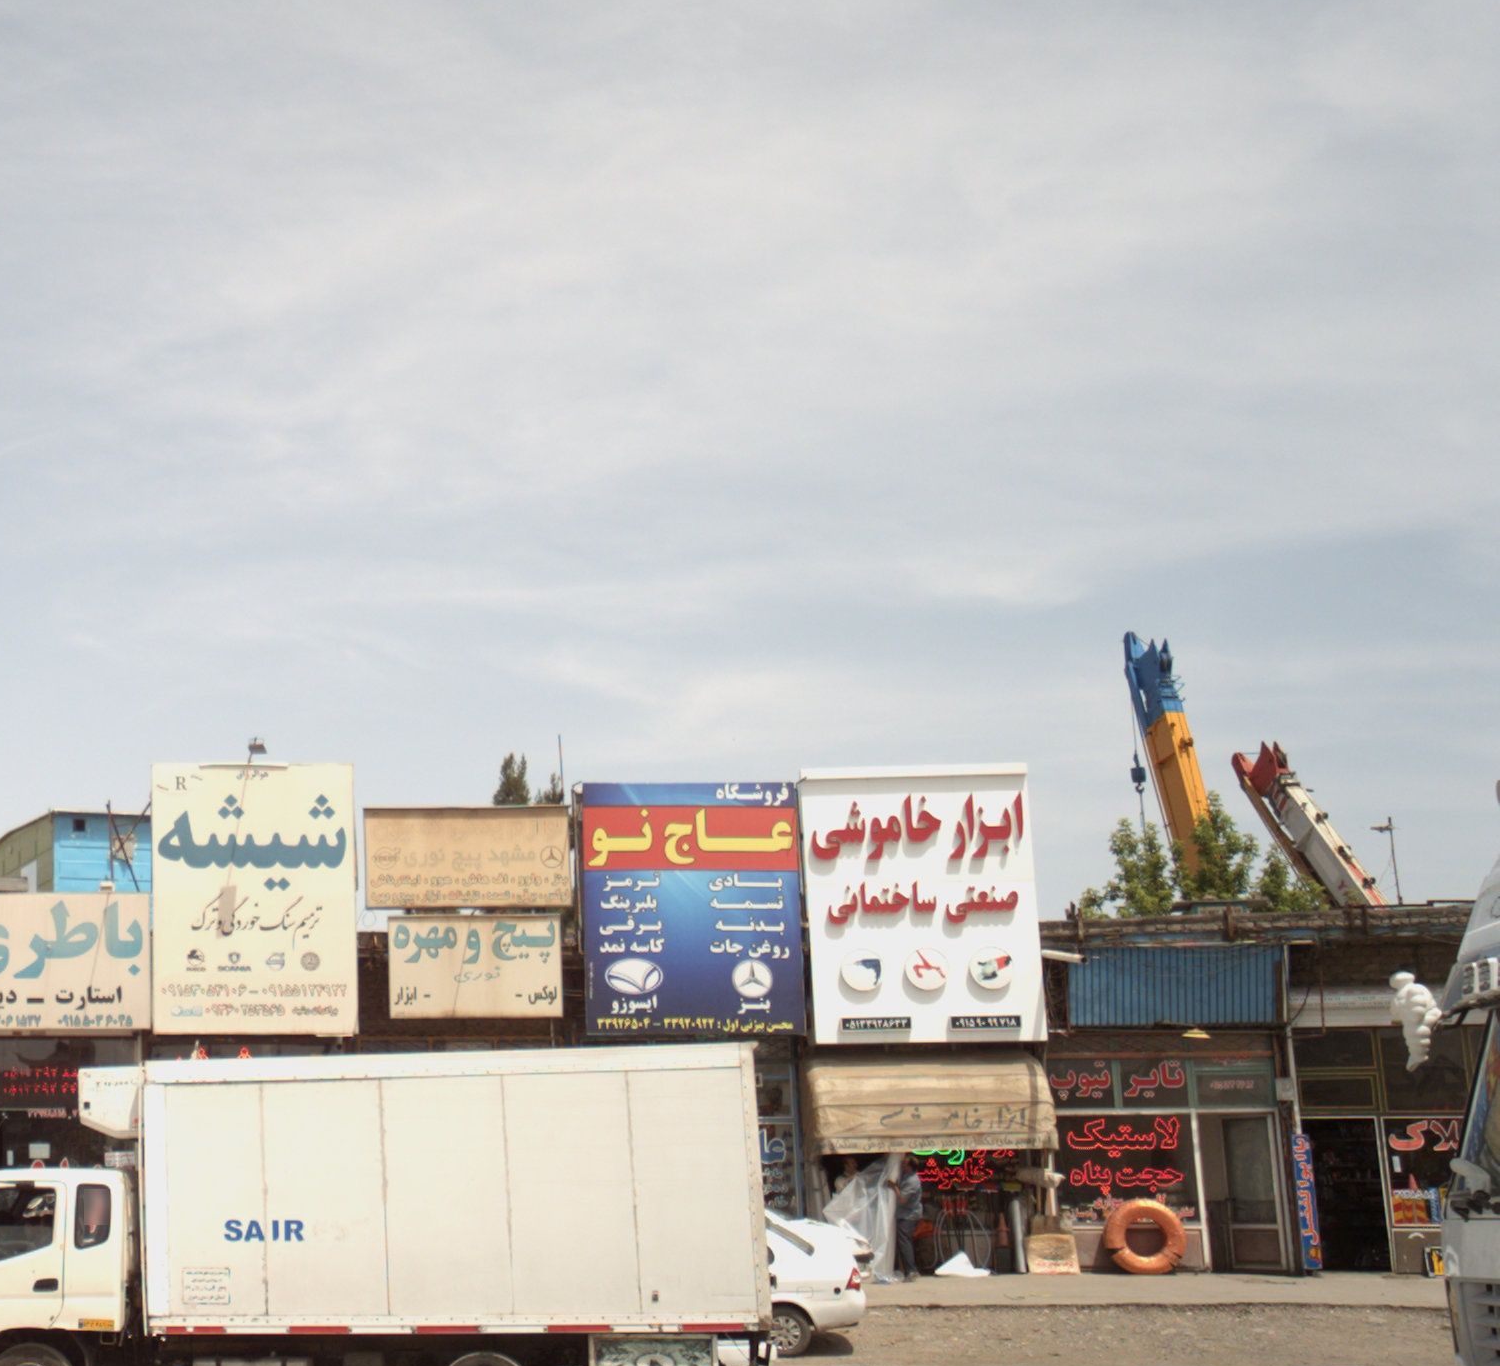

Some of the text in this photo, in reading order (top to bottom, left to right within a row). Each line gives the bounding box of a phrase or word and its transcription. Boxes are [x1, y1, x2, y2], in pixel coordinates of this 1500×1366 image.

[716, 783, 789, 806] فروشگاه
[811, 790, 1024, 861] ابزار خاموشی
[157, 793, 347, 891] شیشه
[587, 808, 794, 867] عاج نو
[602, 872, 661, 892] ترمز
[707, 872, 784, 892] بادی
[600, 894, 658, 913] بلبرینگ
[709, 895, 785, 910] تسمه
[828, 881, 1019, 925] صنعتی ساختمانی
[598, 915, 663, 936] برقی
[393, 919, 556, 964] پیچ و مهره
[599, 937, 665, 954] کاسه نمد
[709, 938, 791, 960] روغن جات
[453, 966, 501, 984] نوری
[55, 985, 123, 1011] استارت
[394, 986, 417, 1006] ابزار
[527, 986, 558, 1006] لوکس
[610, 994, 658, 1015] ایسوزو
[737, 996, 772, 1015] بنز
[1049, 1059, 1186, 1101] تایر تیوپ
[1067, 1116, 1181, 1158] لاستیک
[1388, 1119, 1460, 1152] لاک
[916, 1158, 994, 1190] خاموش
[1069, 1159, 1185, 1196] حجت پناه
[223, 1219, 305, 1243] SAIR
